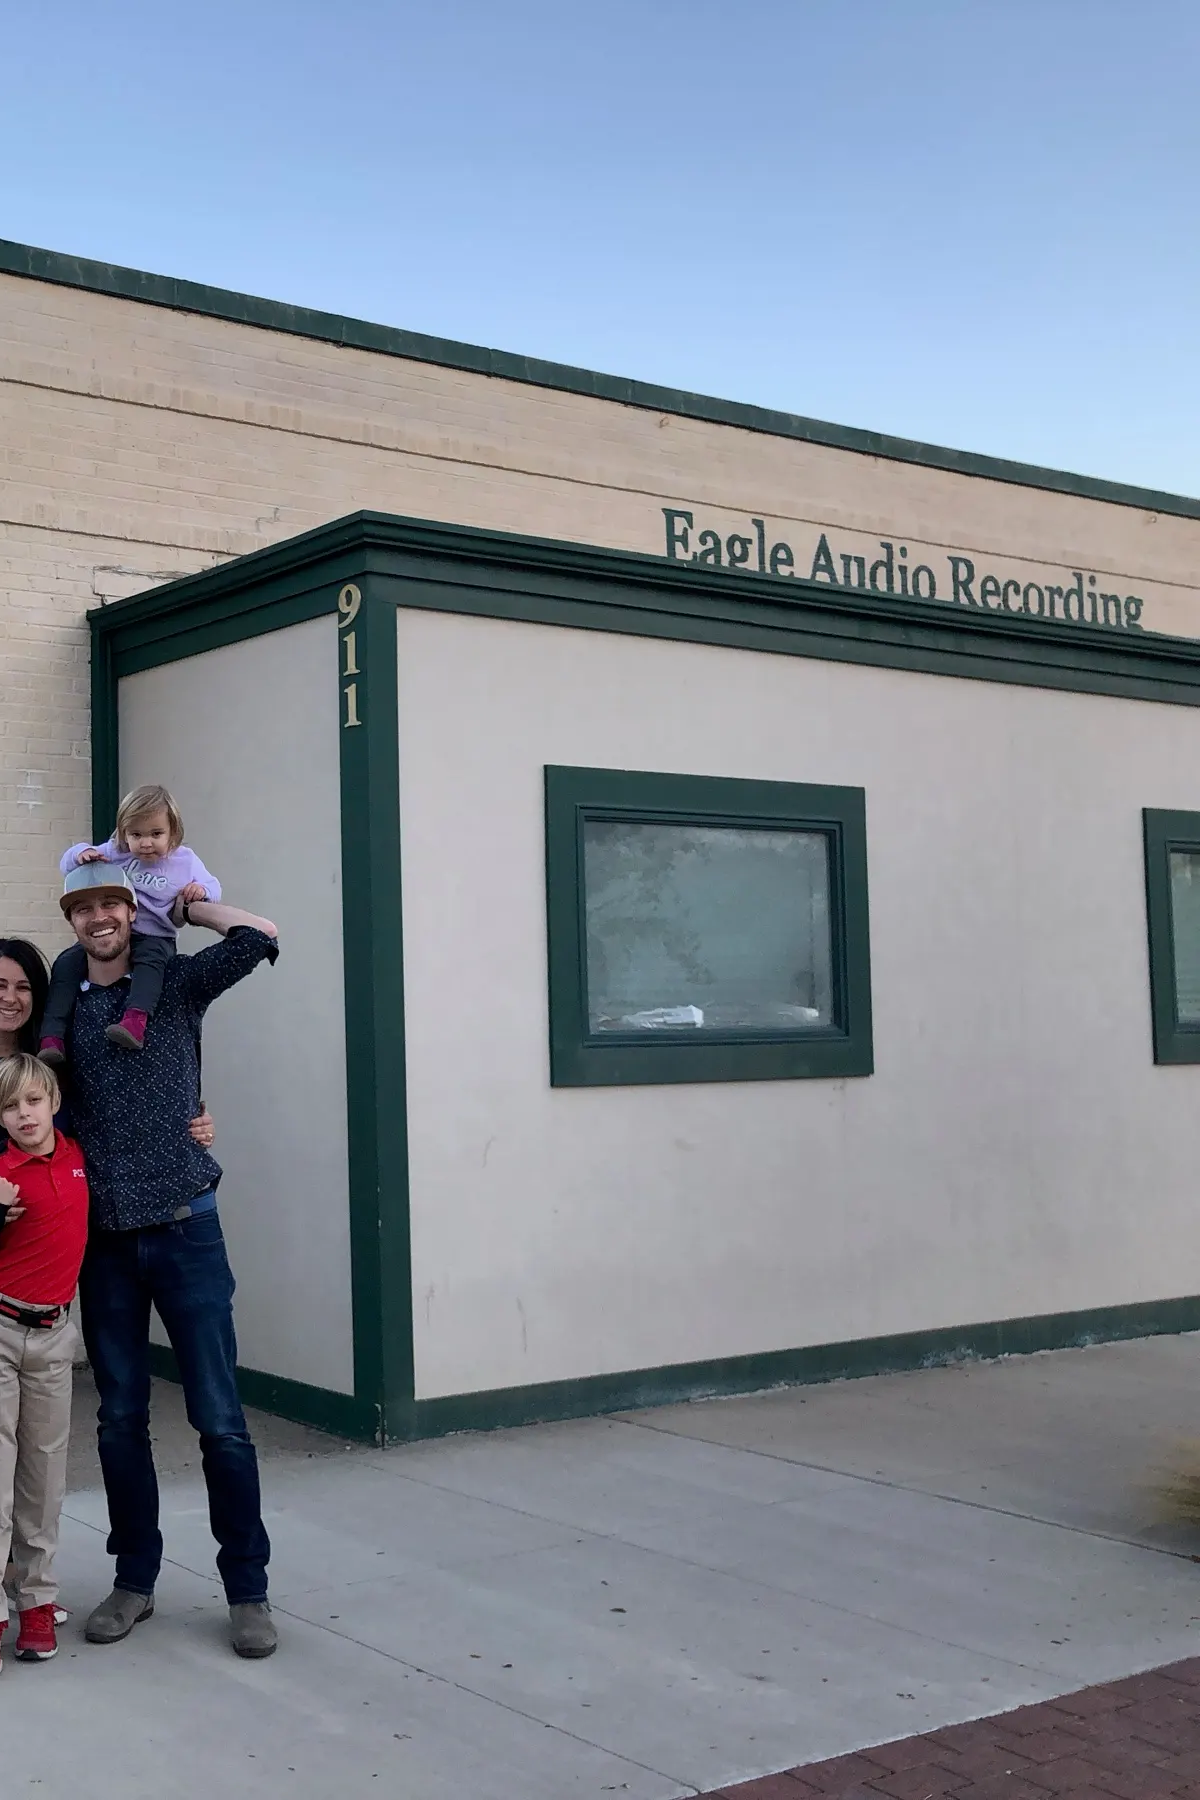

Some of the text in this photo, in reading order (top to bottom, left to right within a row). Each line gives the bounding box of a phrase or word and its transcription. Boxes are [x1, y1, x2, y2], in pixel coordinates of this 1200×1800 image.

[661, 508, 1144, 631] Eagle Audio Recording
[338, 584, 362, 728] 911
